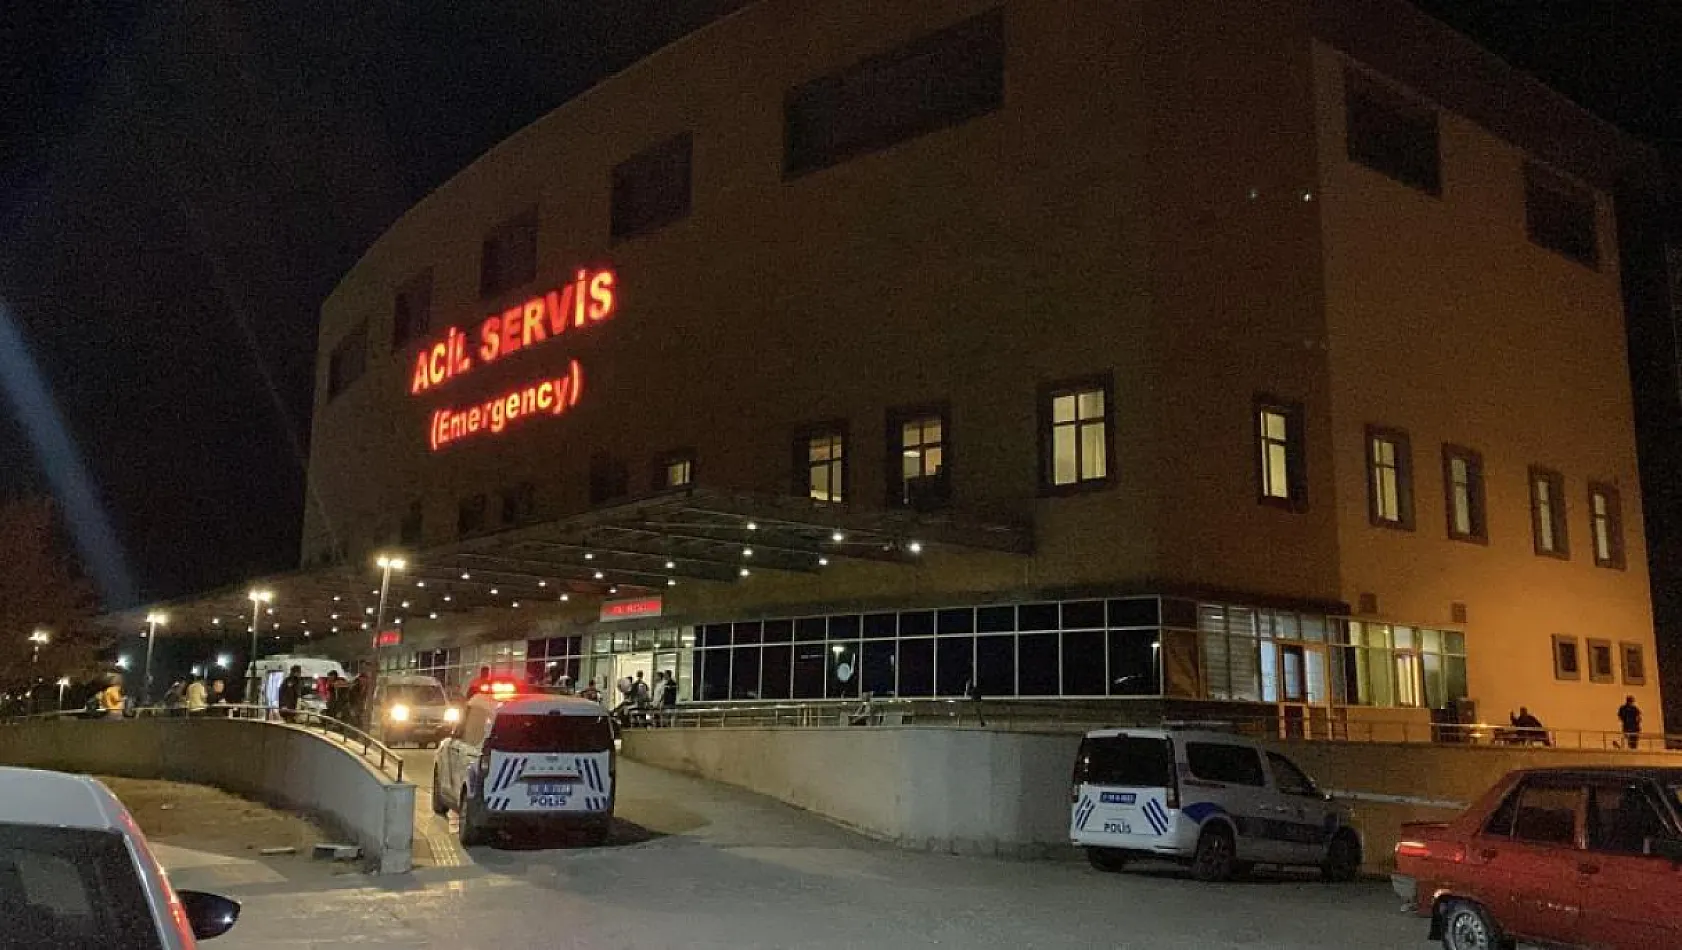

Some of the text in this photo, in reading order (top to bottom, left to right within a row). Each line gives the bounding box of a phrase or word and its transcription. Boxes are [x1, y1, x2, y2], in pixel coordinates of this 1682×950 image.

[411, 268, 614, 395] ACİL SERVİS
[430, 359, 582, 451] (Emergency)
